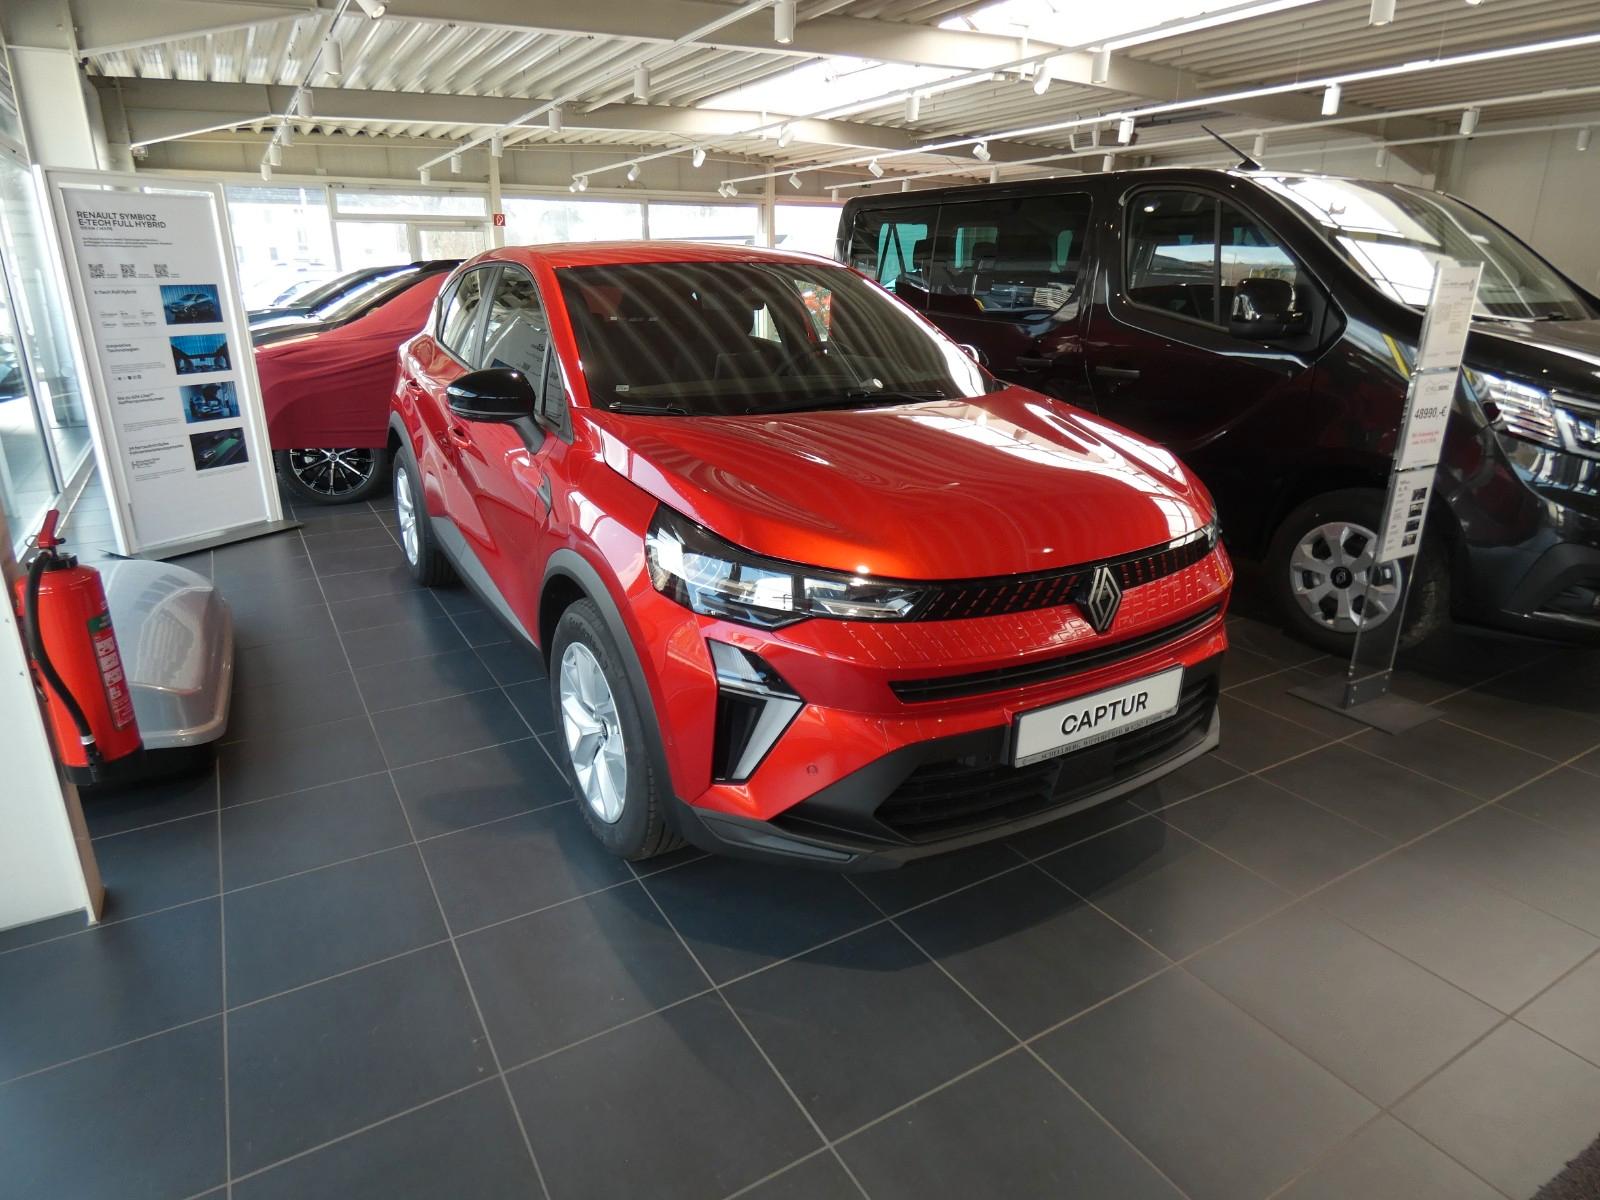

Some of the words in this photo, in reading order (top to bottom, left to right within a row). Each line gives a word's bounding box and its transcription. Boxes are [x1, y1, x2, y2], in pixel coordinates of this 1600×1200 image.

[77, 211, 117, 220] RENAULT
[119, 213, 157, 221] SYMBIOZ
[79, 219, 111, 227] E-TECH
[112, 220, 134, 228] FULL
[135, 221, 167, 229] HYBRID
[1061, 692, 1148, 735] CAPTUR
